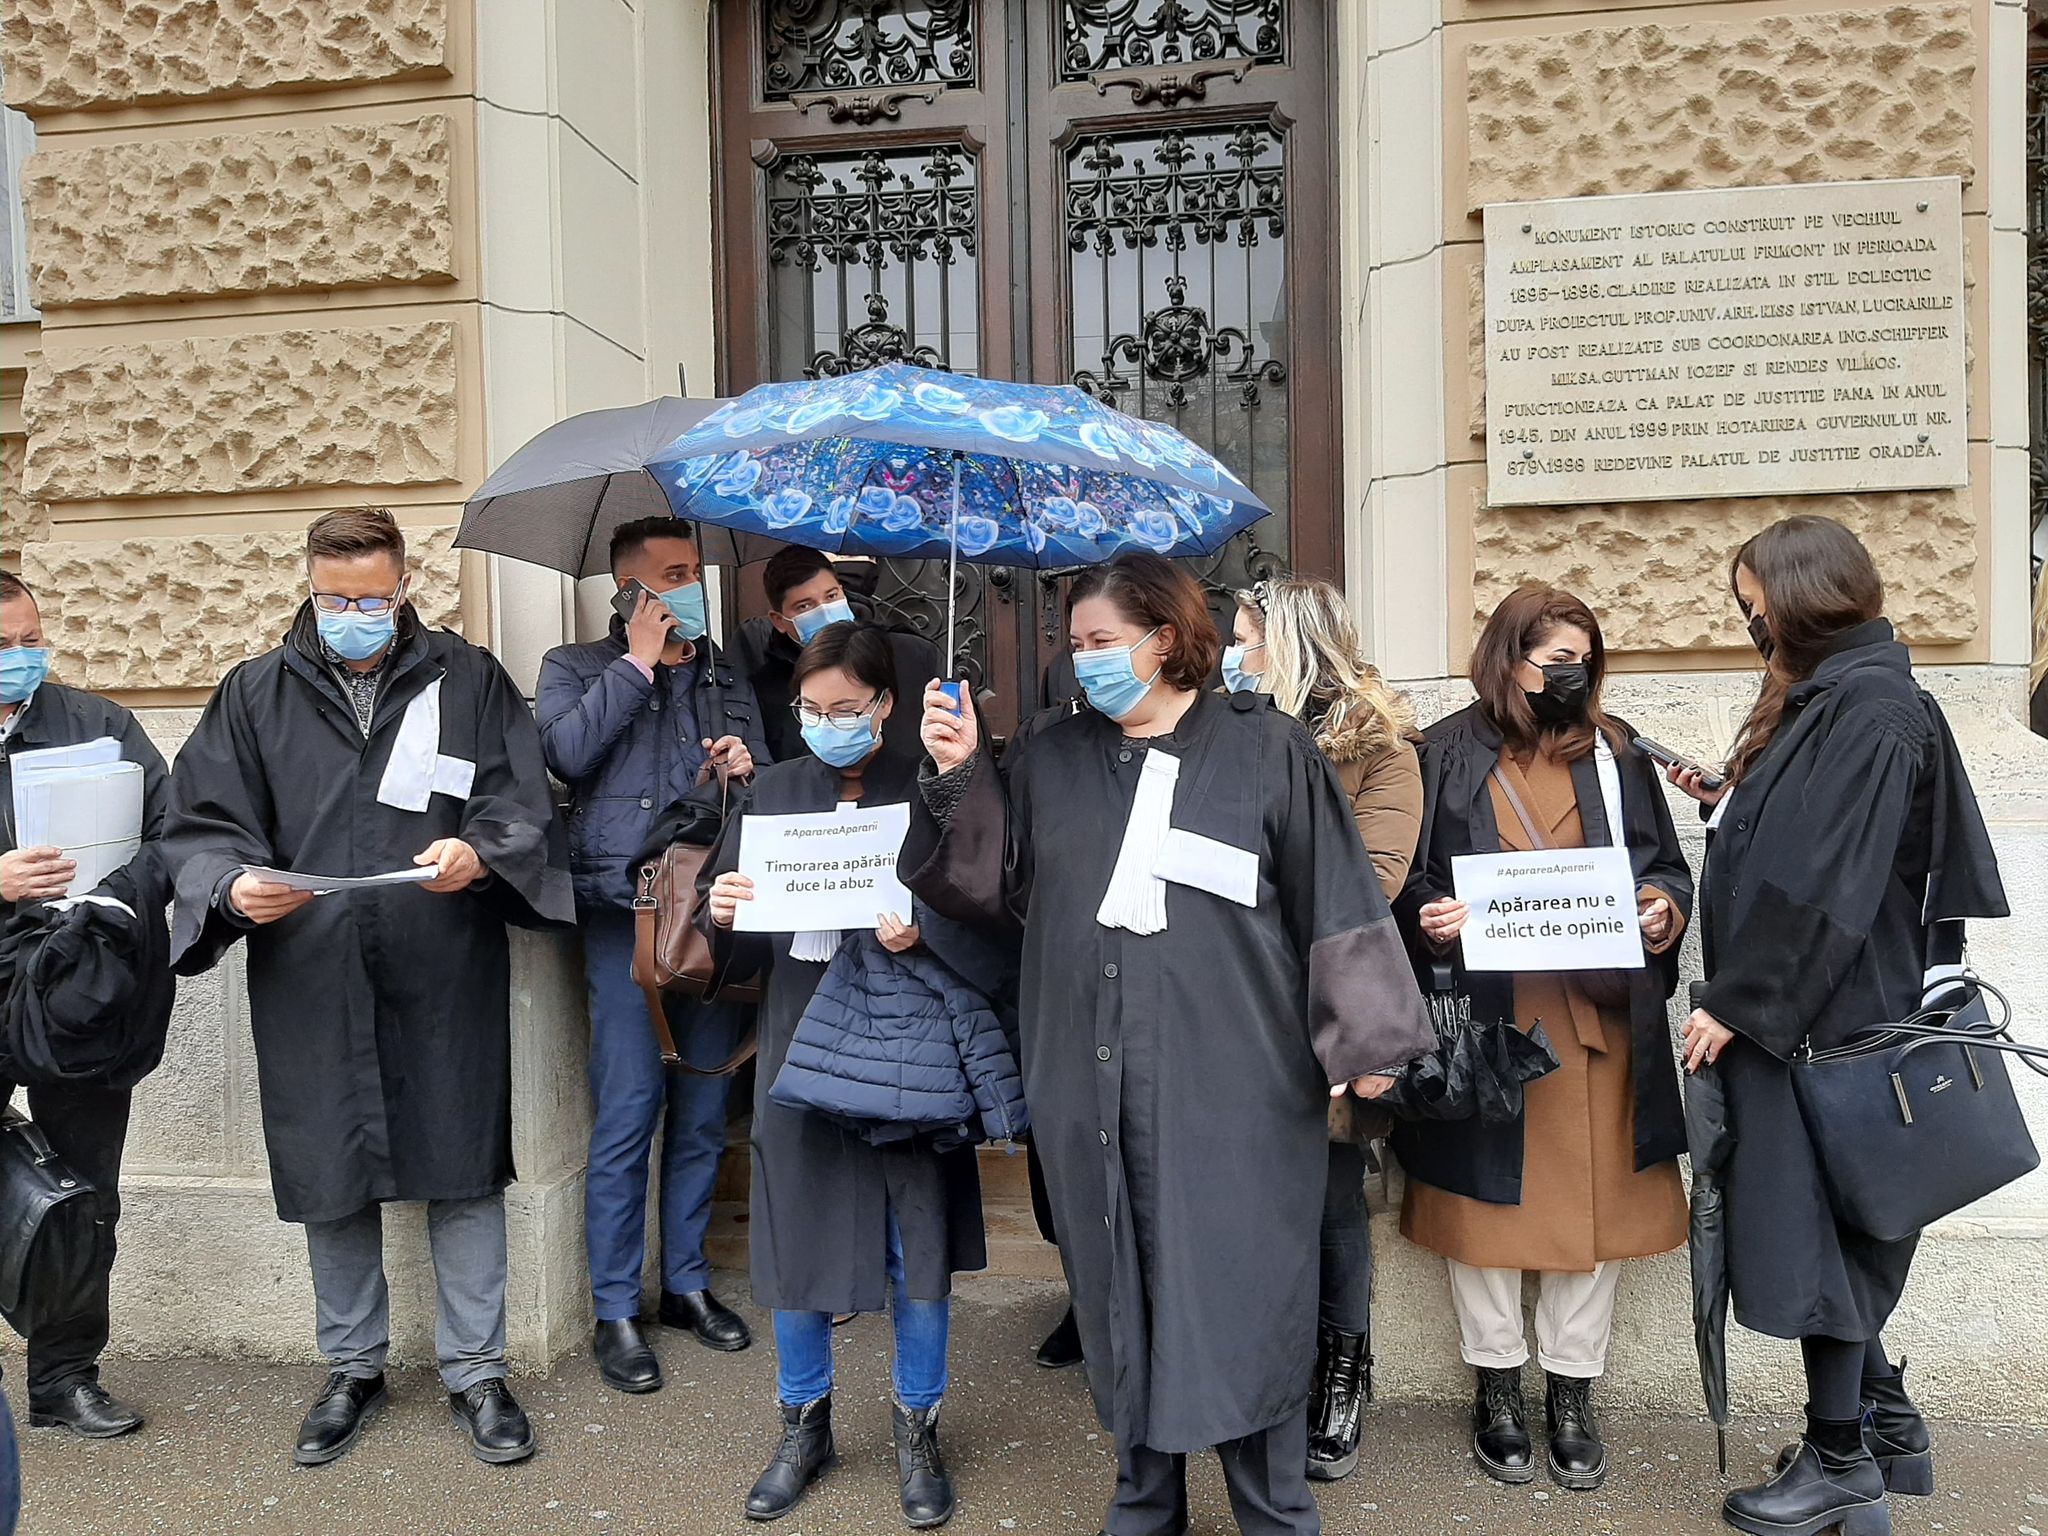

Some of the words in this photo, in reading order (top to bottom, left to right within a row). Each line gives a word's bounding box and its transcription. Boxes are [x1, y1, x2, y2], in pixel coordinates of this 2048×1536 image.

[1535, 227, 1622, 244] MONUMENT
[1630, 223, 1696, 239] ISTORIC
[1703, 217, 1796, 234] CONSTRUIT
[1804, 216, 1824, 229] PE
[1832, 211, 1902, 227] VECHIUL
[1509, 255, 1624, 274] AMPLASAMENT
[1632, 252, 1653, 266] AL
[1662, 246, 1747, 265] PALATULUI
[1754, 243, 1826, 259] FRIMONT
[1833, 242, 1851, 255] IN
[1857, 239, 1937, 254] PERIOADA
[1684, 275, 1771, 293] REALIZATA
[1779, 275, 1796, 288] IN
[1804, 272, 1839, 287] STIL
[1848, 268, 1932, 285] ECLECTIC
[1496, 319, 1535, 333] DUPA
[1540, 313, 1630, 331] PROIECTUL
[1500, 348, 1521, 362] AU
[1527, 345, 1570, 360] FOST
[1578, 340, 1664, 357] REALIZATE
[1672, 338, 1701, 352] SUB
[1708, 332, 1834, 350] COORDONAREA
[1687, 364, 1736, 379] IOZEF
[1743, 363, 1758, 376] SI
[1766, 359, 1828, 374] RENDES
[1504, 400, 1628, 417] FUNCTIONEAZA
[1636, 398, 1659, 410] CA
[1666, 394, 1716, 409] PALAT
[1723, 393, 1746, 406] DE
[1753, 389, 1826, 405] JUSTITIE
[1833, 387, 1875, 401] PANA
[1882, 386, 1900, 399] IN
[1904, 384, 1947, 398] ANUL
[1499, 428, 1543, 444] 1945.
[1550, 428, 1577, 443] DIN
[1584, 425, 1627, 441] ANUL
[1629, 421, 1669, 438] 1999
[1672, 421, 1709, 436] PRIN
[1716, 415, 1807, 434] HOTARIREA
[1816, 413, 1919, 430] GUVERNULUI
[1926, 411, 1952, 425] NR.
[1594, 455, 1673, 472] REDEVINE
[1681, 450, 1750, 468] PALATUL
[1758, 450, 1781, 463] DE
[1789, 446, 1861, 462] JUSTITIE
[1869, 443, 1942, 459] ORADEA.
[784, 821, 879, 838] #AparareaApararii
[765, 859, 839, 872] Timorarea
[843, 853, 895, 872] apărării
[1497, 862, 1595, 878] #AparareaApararii
[786, 880, 820, 892] duce
[824, 878, 836, 891] la
[840, 877, 874, 889] abuz
[1488, 897, 1571, 917] Apărarea
[1577, 896, 1599, 908] nu
[1605, 895, 1616, 906] e
[1485, 922, 1535, 938] delict
[1540, 920, 1562, 937] de
[1567, 917, 1624, 939] opinie
